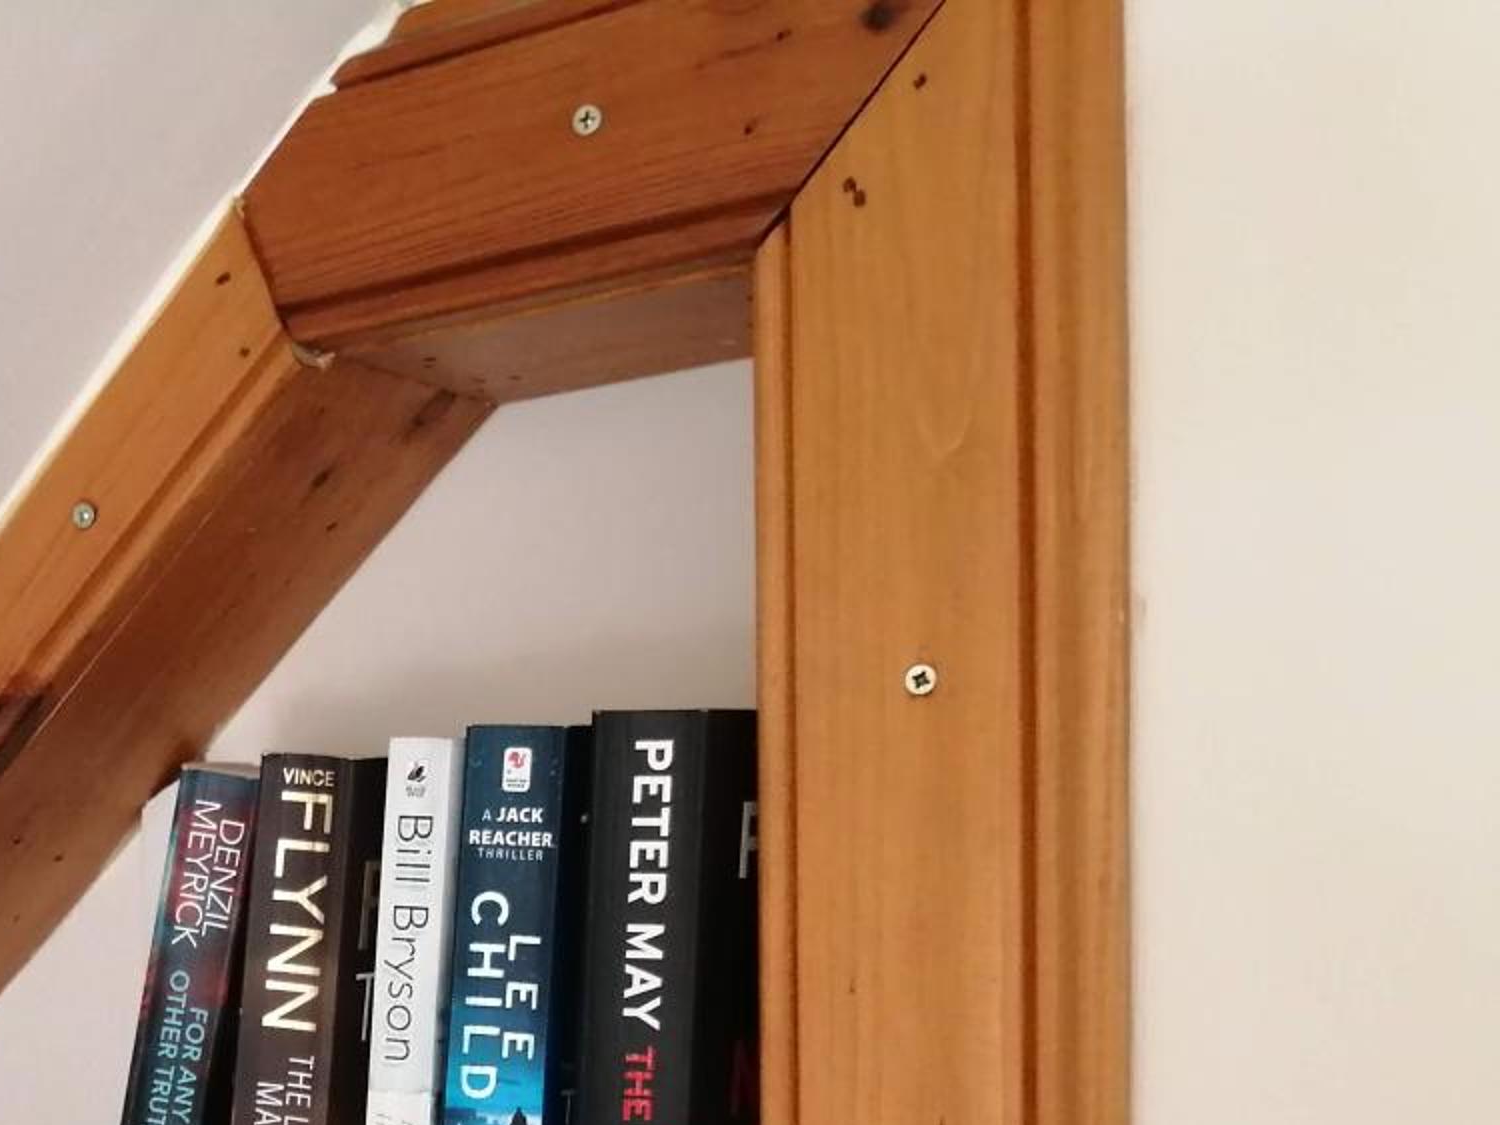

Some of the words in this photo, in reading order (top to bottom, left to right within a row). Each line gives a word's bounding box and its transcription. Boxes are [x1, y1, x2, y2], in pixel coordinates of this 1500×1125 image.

[283, 767, 335, 787] VINCE
[481, 808, 492, 821] A
[495, 806, 544, 823] JACK
[395, 815, 433, 883] Bill
[468, 829, 553, 848] REACHER
[477, 847, 544, 861] THRILLER
[627, 739, 674, 905] PETER
[171, 799, 223, 948] MEYRICK
[202, 819, 245, 937] DENZIL
[261, 790, 333, 1033] FLYNN
[157, 970, 190, 1059] OTHER
[384, 905, 429, 1061] Bryson
[460, 891, 509, 1100] CHILD
[501, 935, 542, 1061] LEE
[622, 923, 666, 1032] MAY
[180, 1007, 208, 1061] FOR
[171, 1065, 197, 1124] ANY
[285, 1055, 315, 1108] THE
[621, 1047, 656, 1122] THE
